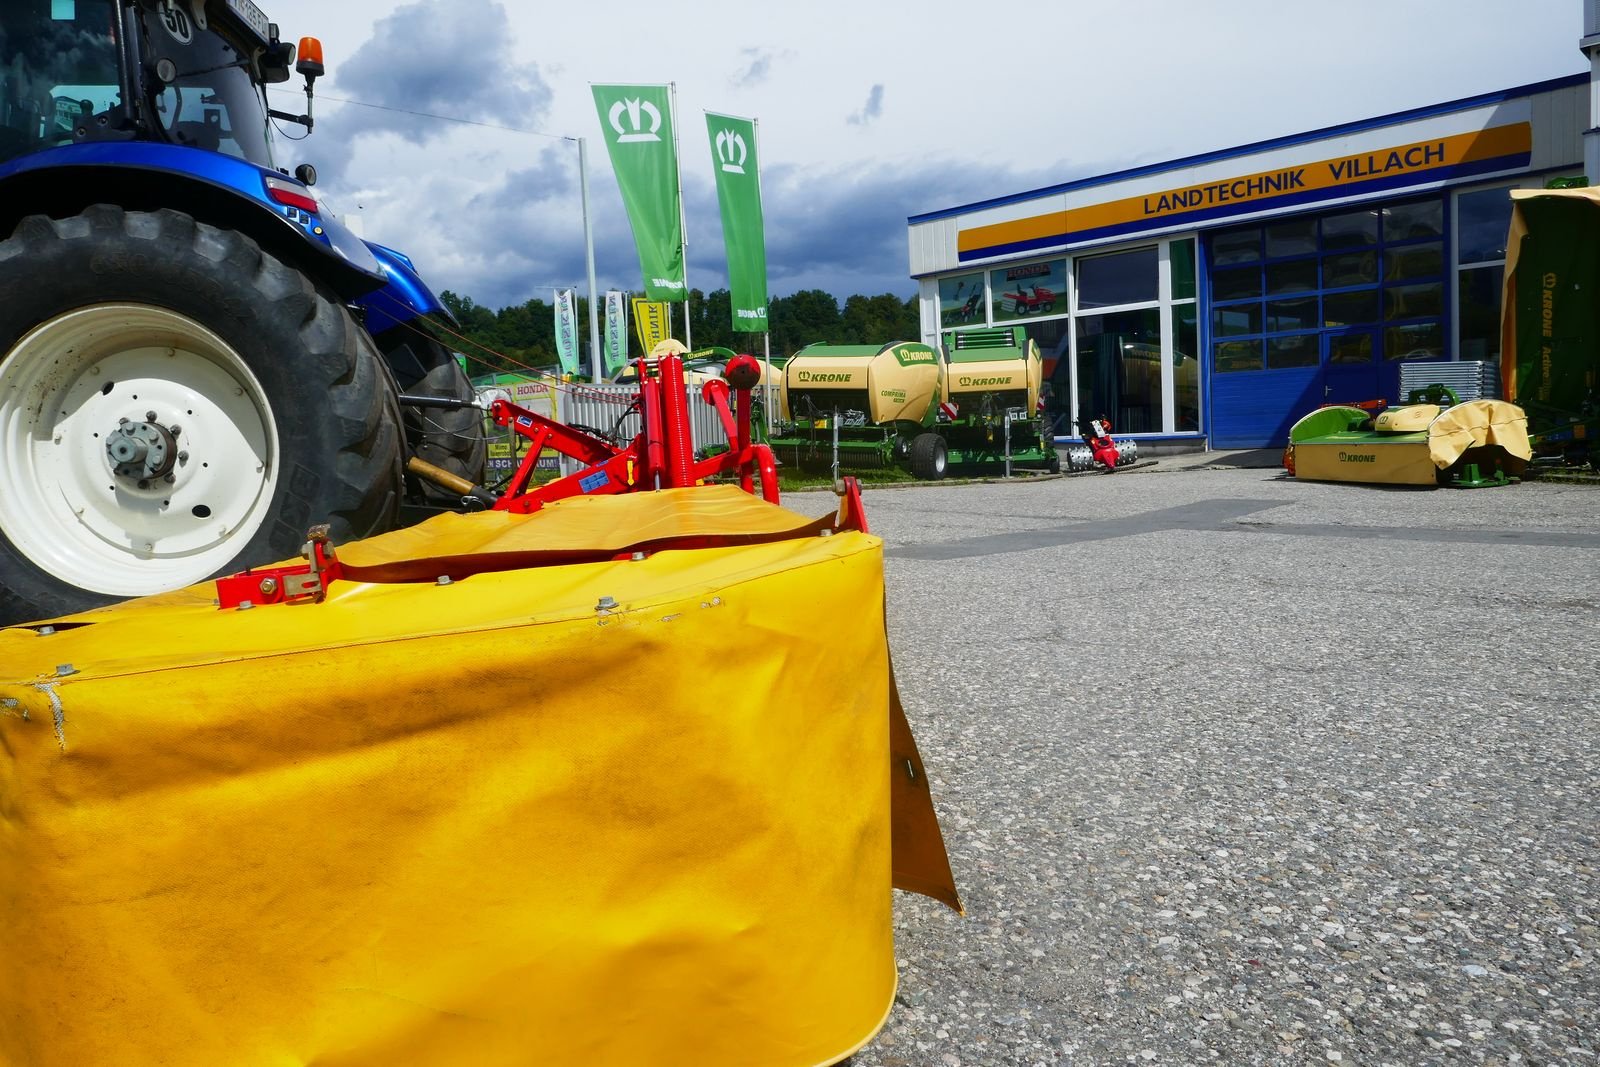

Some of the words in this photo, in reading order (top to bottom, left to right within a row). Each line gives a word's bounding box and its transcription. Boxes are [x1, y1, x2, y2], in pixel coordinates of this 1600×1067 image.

[164, 5, 190, 39] 50
[1143, 169, 1306, 215] LANDTECHNIK
[1328, 142, 1446, 181] VILLACH
[1008, 263, 1050, 277] HONDA
[1542, 289, 1553, 337] KRONE
[693, 349, 714, 358] KRONE
[910, 351, 933, 360] KRONE
[810, 373, 852, 383] KRONE
[971, 376, 1013, 387] KRONE
[517, 384, 549, 395] HONDA
[881, 390, 906, 398] COMPRIMA
[1347, 453, 1376, 463] KRONE
